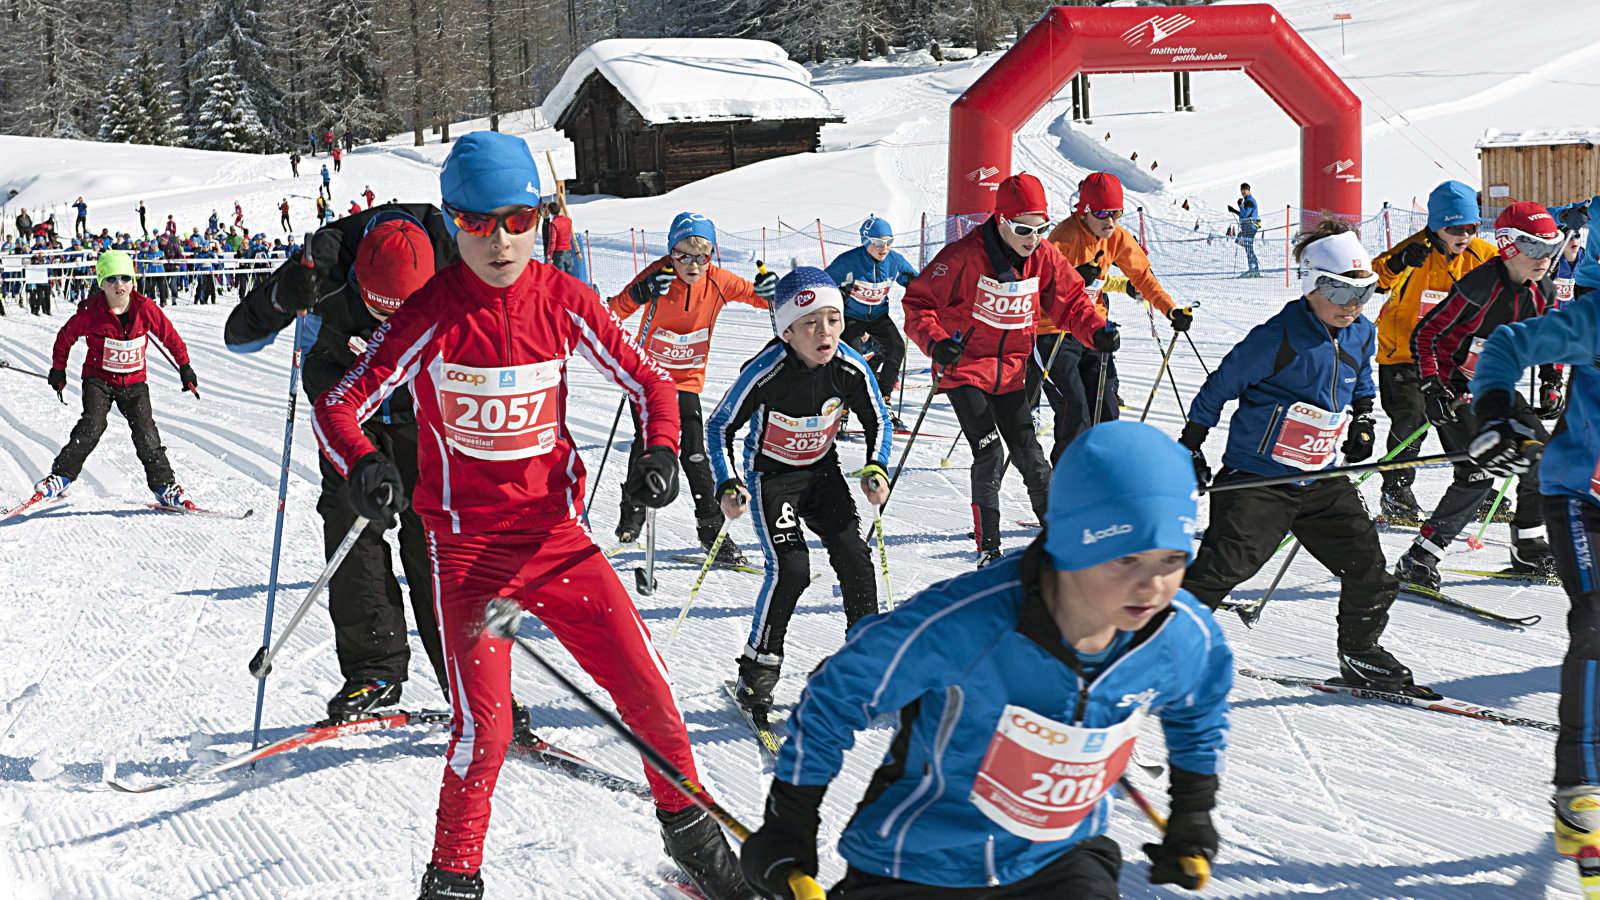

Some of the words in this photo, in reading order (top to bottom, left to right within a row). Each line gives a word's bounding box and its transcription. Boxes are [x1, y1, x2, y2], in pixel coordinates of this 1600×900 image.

[1150, 46, 1196, 54] matterhorn
[982, 279, 1003, 290] coop
[982, 293, 1032, 313] 2046
[109, 348, 142, 363] 2051
[662, 347, 694, 358] 2020
[447, 370, 486, 386] coop
[455, 392, 547, 431] 2057
[1294, 405, 1322, 419] coop
[773, 413, 799, 427] coop
[784, 434, 828, 450] 2029
[794, 431, 824, 439] MATIAS
[1094, 524, 1134, 540] odlo
[1350, 658, 1392, 676] SALOMON
[1011, 714, 1069, 745] coop
